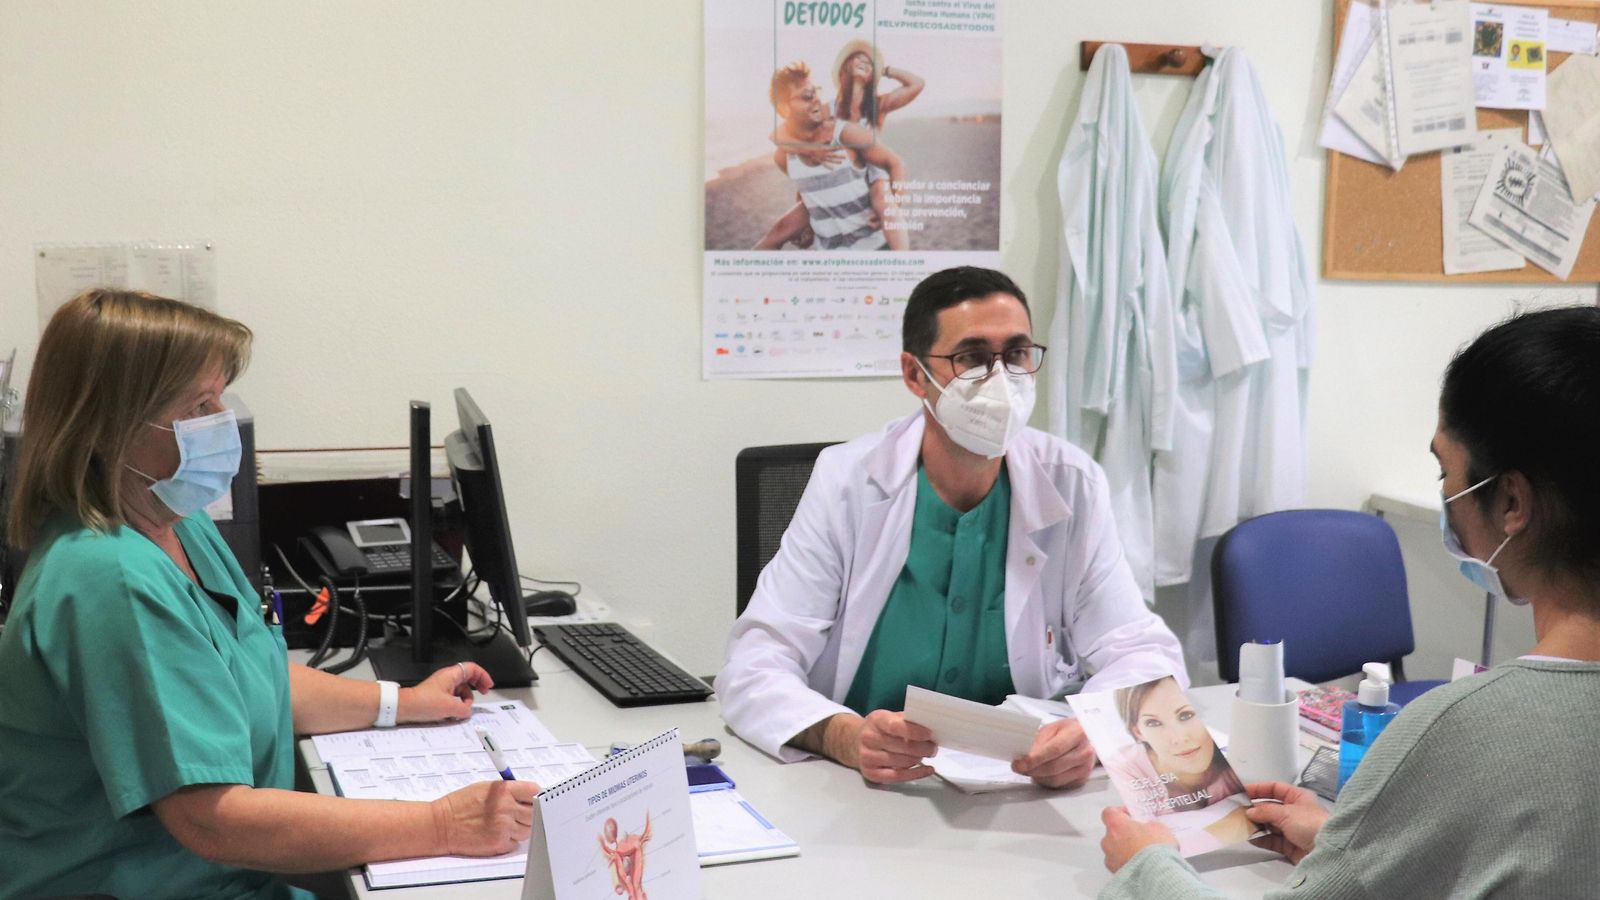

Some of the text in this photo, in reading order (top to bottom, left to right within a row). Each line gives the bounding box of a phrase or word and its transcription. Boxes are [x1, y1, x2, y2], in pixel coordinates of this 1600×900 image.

[784, 1, 866, 28] DETODOS
[904, 9, 938, 18] Papiloma
[878, 20, 995, 32] #ELVPHESCOSADETODOS
[891, 181, 926, 192] ayudar
[936, 181, 991, 192] concienciar
[912, 194, 922, 204] la
[924, 194, 982, 206] importancia
[732, 257, 783, 266] información
[1128, 772, 1177, 790] EOPLASIA
[587, 769, 648, 807] TIPOS DE MIOMAS UTERINOS
